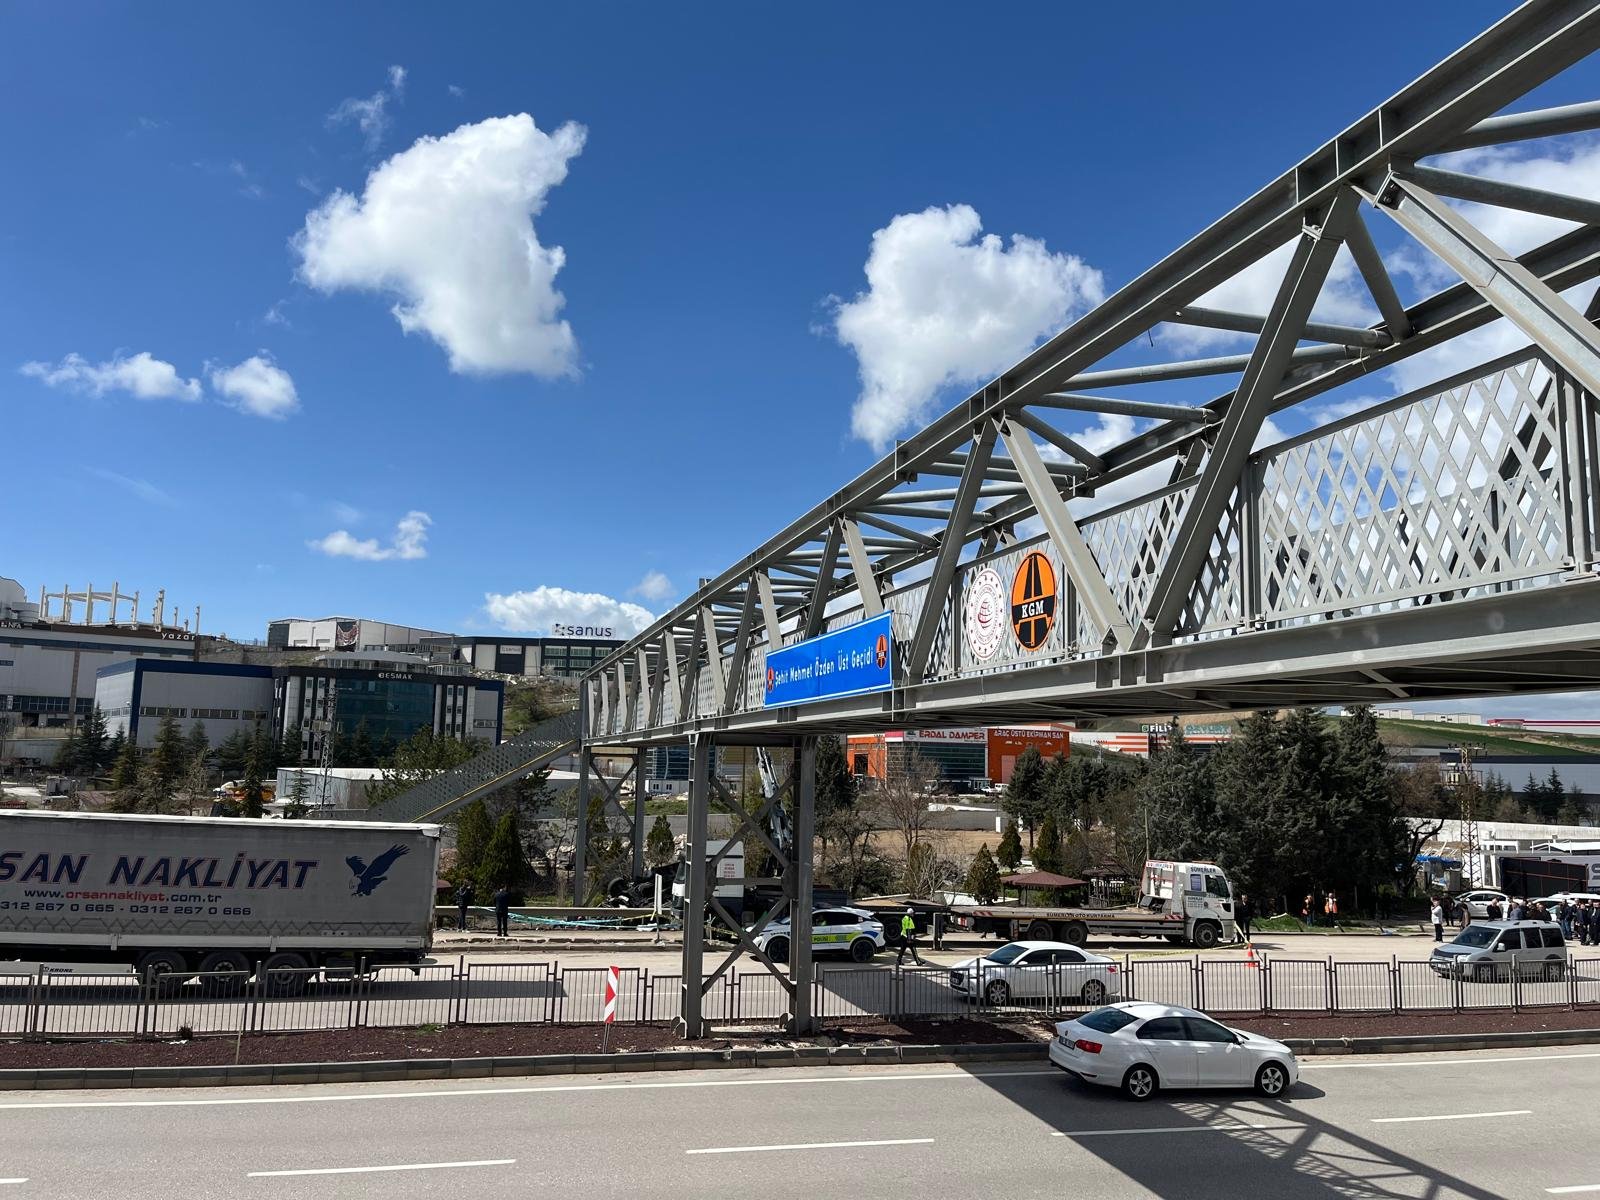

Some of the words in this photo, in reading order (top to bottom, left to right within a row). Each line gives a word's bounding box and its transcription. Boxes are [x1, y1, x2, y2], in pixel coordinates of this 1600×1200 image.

[1021, 601, 1044, 618] KGM
[161, 632, 195, 641] yazar
[567, 625, 612, 637] sanus
[790, 663, 813, 682] Mehmet
[814, 656, 835, 677] Özden
[838, 649, 849, 671] Üst
[852, 646, 874, 668] Geçidi
[919, 730, 947, 739] ERDAL
[949, 731, 985, 740] DAMPER
[107, 852, 318, 889] NAKLİYAT
[24, 889, 222, 903] www.orsannakliyat.com.tr
[35, 902, 65, 911] 267
[70, 903, 80, 912] 0
[85, 904, 115, 912] 665
[129, 905, 169, 914] 0312
[174, 906, 203, 915] 267
[208, 906, 218, 915] 0
[223, 907, 252, 915] 666
